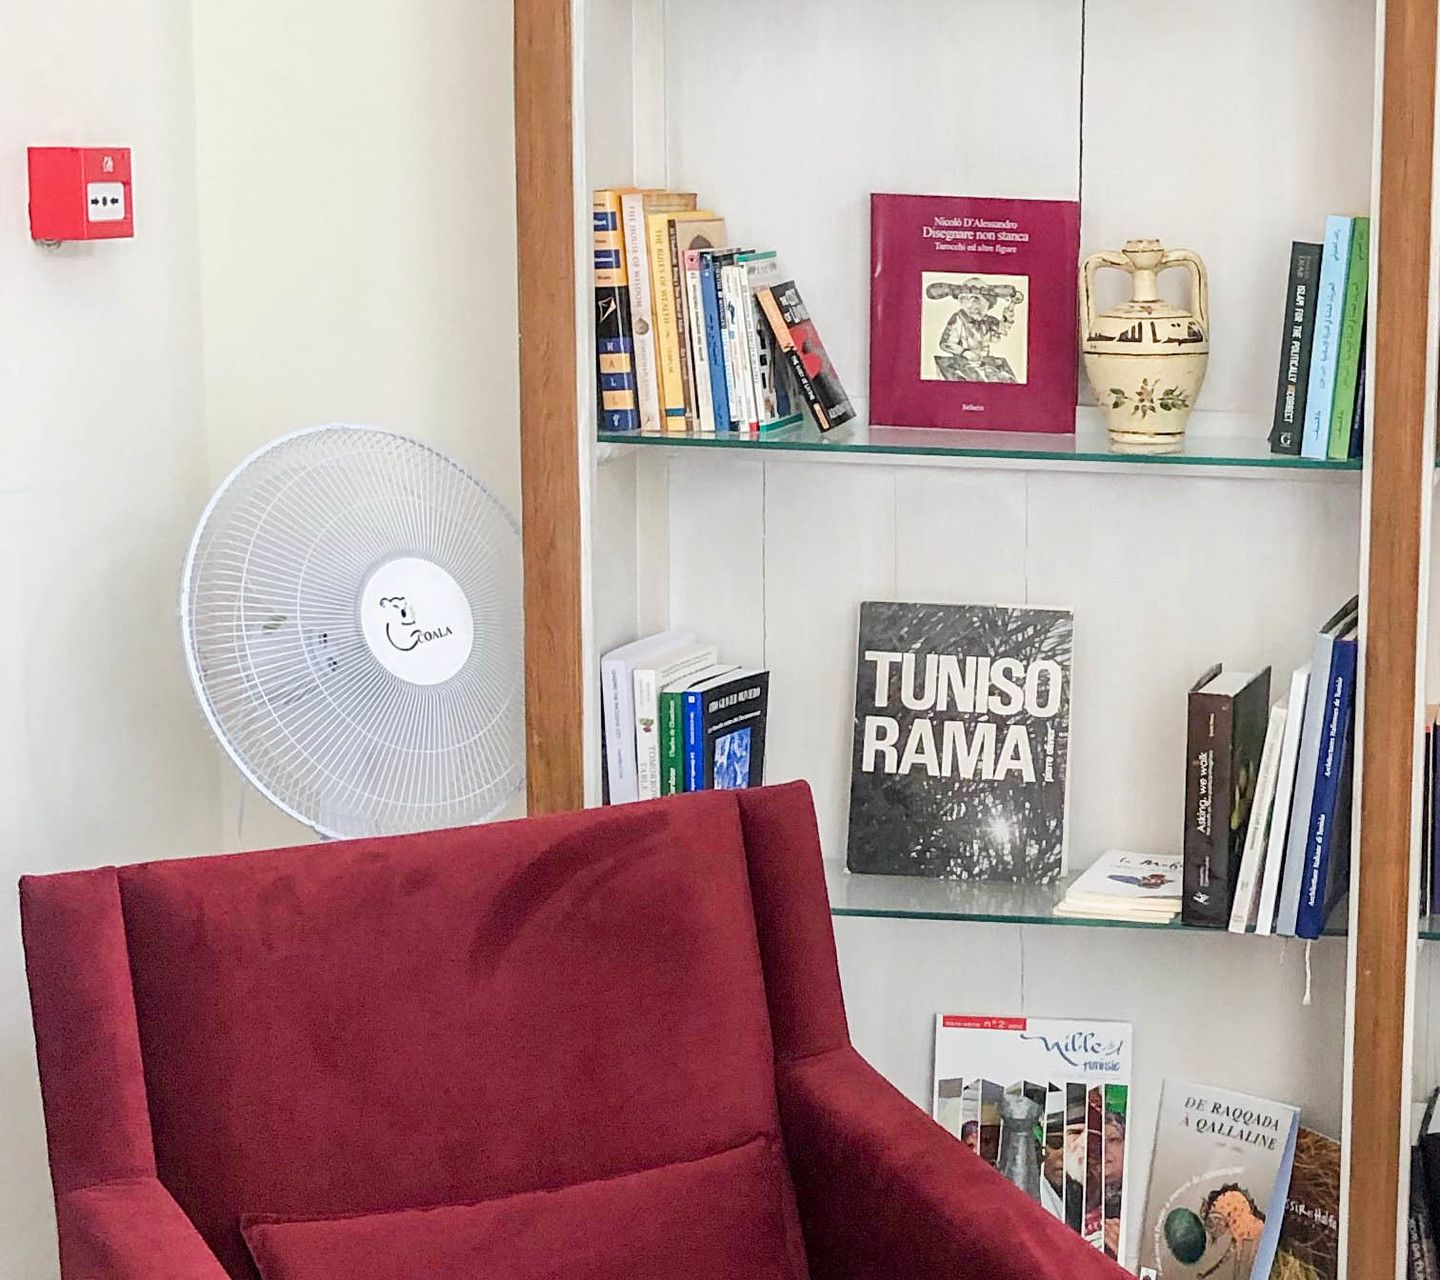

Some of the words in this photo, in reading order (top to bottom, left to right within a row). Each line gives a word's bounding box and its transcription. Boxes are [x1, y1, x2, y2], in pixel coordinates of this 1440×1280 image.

[654, 229, 663, 244] THE
[923, 226, 974, 241] Disegnare
[976, 231, 995, 240] non
[997, 231, 1029, 241] stanca
[633, 270, 642, 307] WISDOM
[659, 276, 666, 286] OF
[1295, 284, 1305, 306] ISLAM
[660, 289, 670, 324] WEALTH
[1294, 307, 1303, 322] FOR
[1292, 325, 1302, 338] THE
[1287, 340, 1300, 381] POLITICALLY
[865, 650, 1063, 718] TUNISO
[861, 716, 1038, 784] RAMA
[1198, 752, 1207, 774] walk
[1198, 777, 1206, 794] we
[1184, 1097, 1207, 1112] DE
[1211, 1102, 1280, 1131] RAQQADA
[1196, 1118, 1278, 1151] QALLALINE
